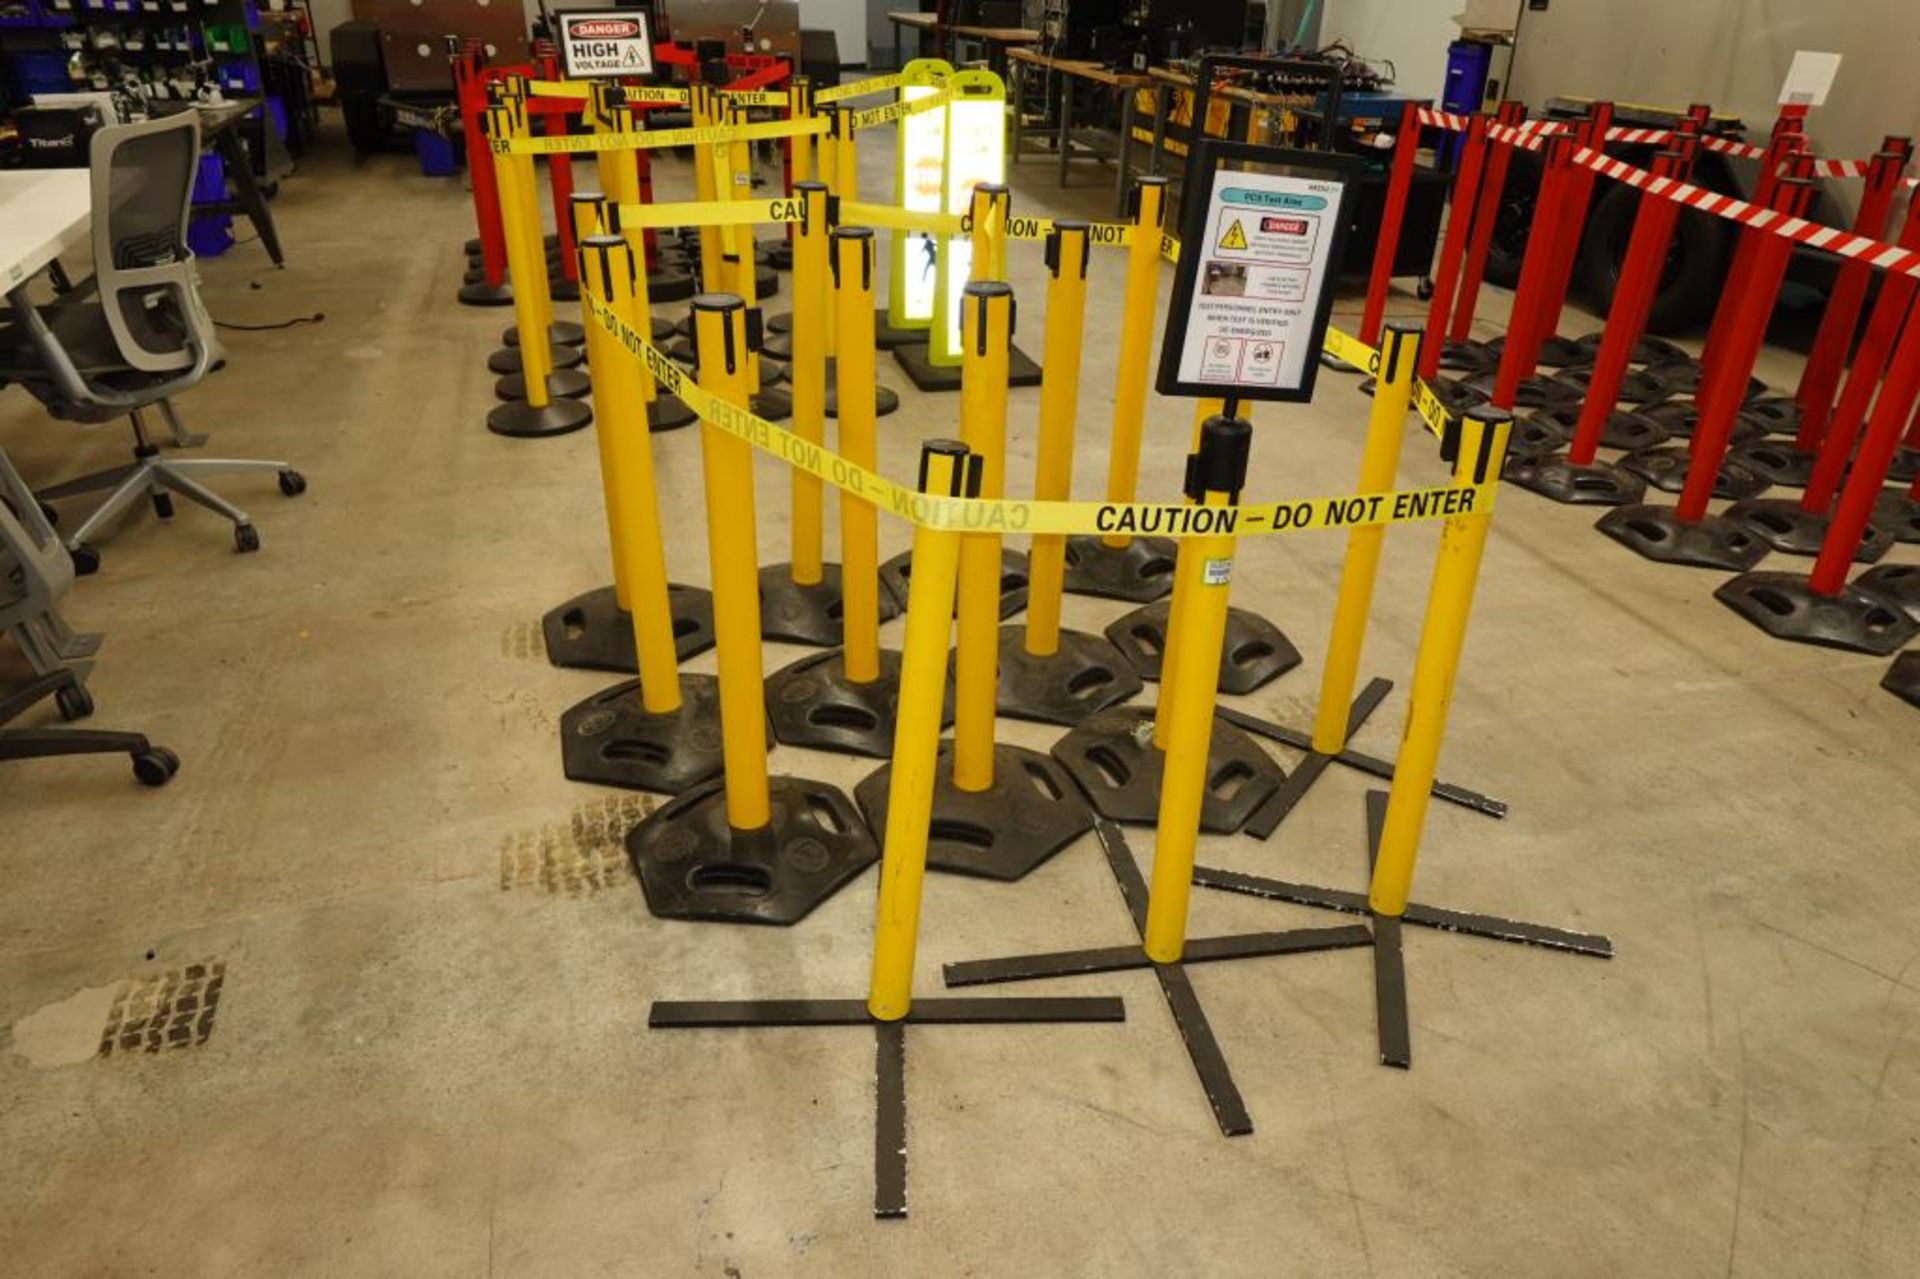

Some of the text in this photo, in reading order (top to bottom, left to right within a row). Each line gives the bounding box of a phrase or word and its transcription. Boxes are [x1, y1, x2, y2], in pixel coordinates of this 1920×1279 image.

[579, 23, 629, 35] DANGER
[572, 42, 619, 58] HIGH
[574, 60, 620, 70] VOLTAGE
[1089, 226, 1125, 243] NOT
[1268, 221, 1301, 232] DANGER
[621, 324, 642, 357] NOT
[646, 345, 682, 395] ENTER
[1095, 505, 1238, 534] CAUTION
[1272, 503, 1313, 530] DO
[1324, 496, 1384, 526] NOT
[1392, 487, 1476, 519] ENTER
